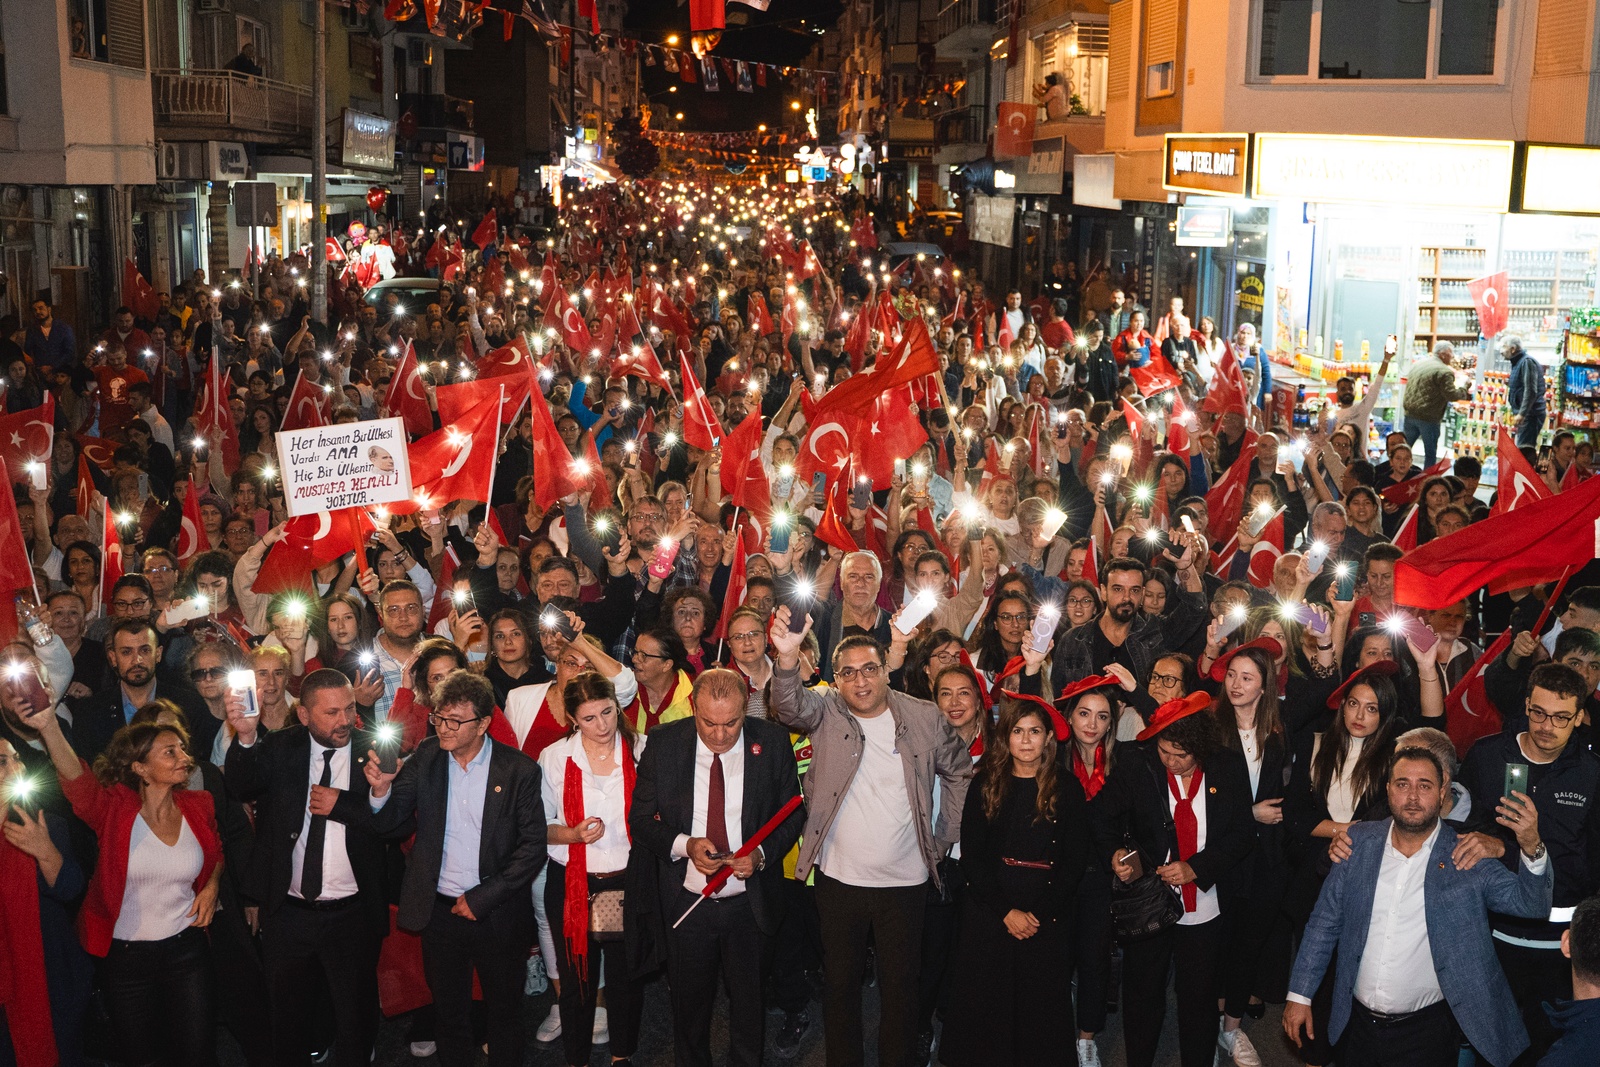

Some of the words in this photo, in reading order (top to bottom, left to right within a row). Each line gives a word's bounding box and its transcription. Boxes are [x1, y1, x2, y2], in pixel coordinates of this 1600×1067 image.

[290, 436, 315, 452] Her
[318, 430, 350, 448] İnsanın
[326, 445, 358, 461] AMA
[294, 469, 313, 483] Hiç
[317, 465, 333, 479] Bir
[337, 461, 374, 476] Ülkenin
[294, 481, 345, 499] MUSTAFA
[1554, 792, 1586, 802] BALÇOVA
